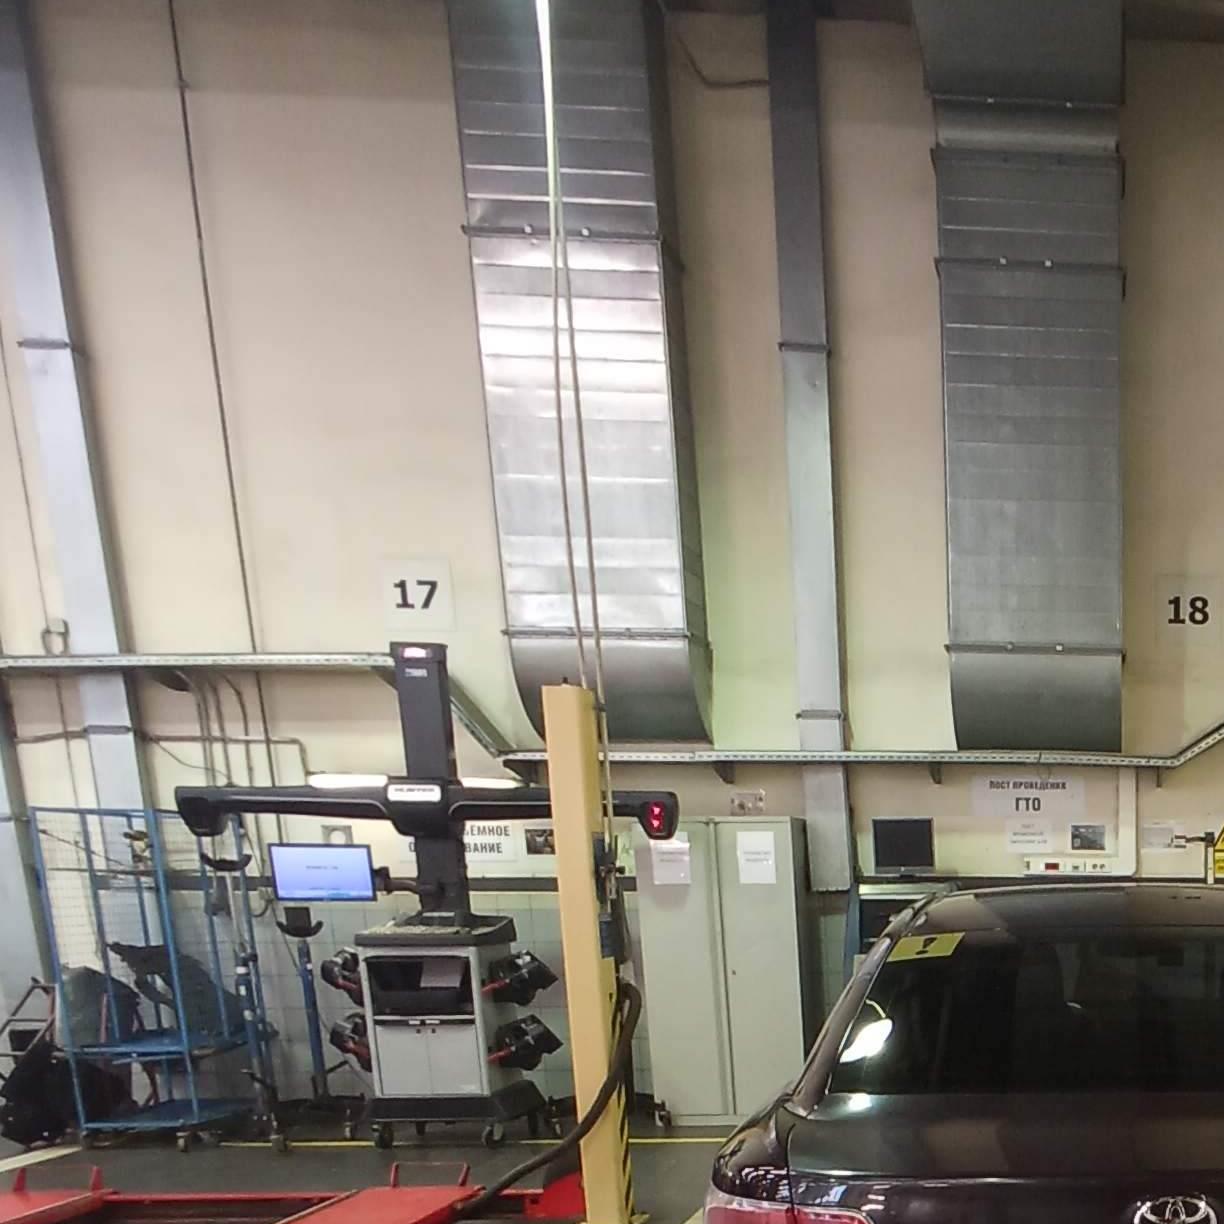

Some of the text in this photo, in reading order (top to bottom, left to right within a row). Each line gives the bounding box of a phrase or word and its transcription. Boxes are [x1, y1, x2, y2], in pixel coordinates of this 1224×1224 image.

[393, 579, 439, 609] 17
[1167, 596, 1210, 625] 18
[989, 780, 1010, 790] ПОСТ
[1015, 797, 1042, 812] ГТО
[464, 825, 511, 837] ЕМНОЕ
